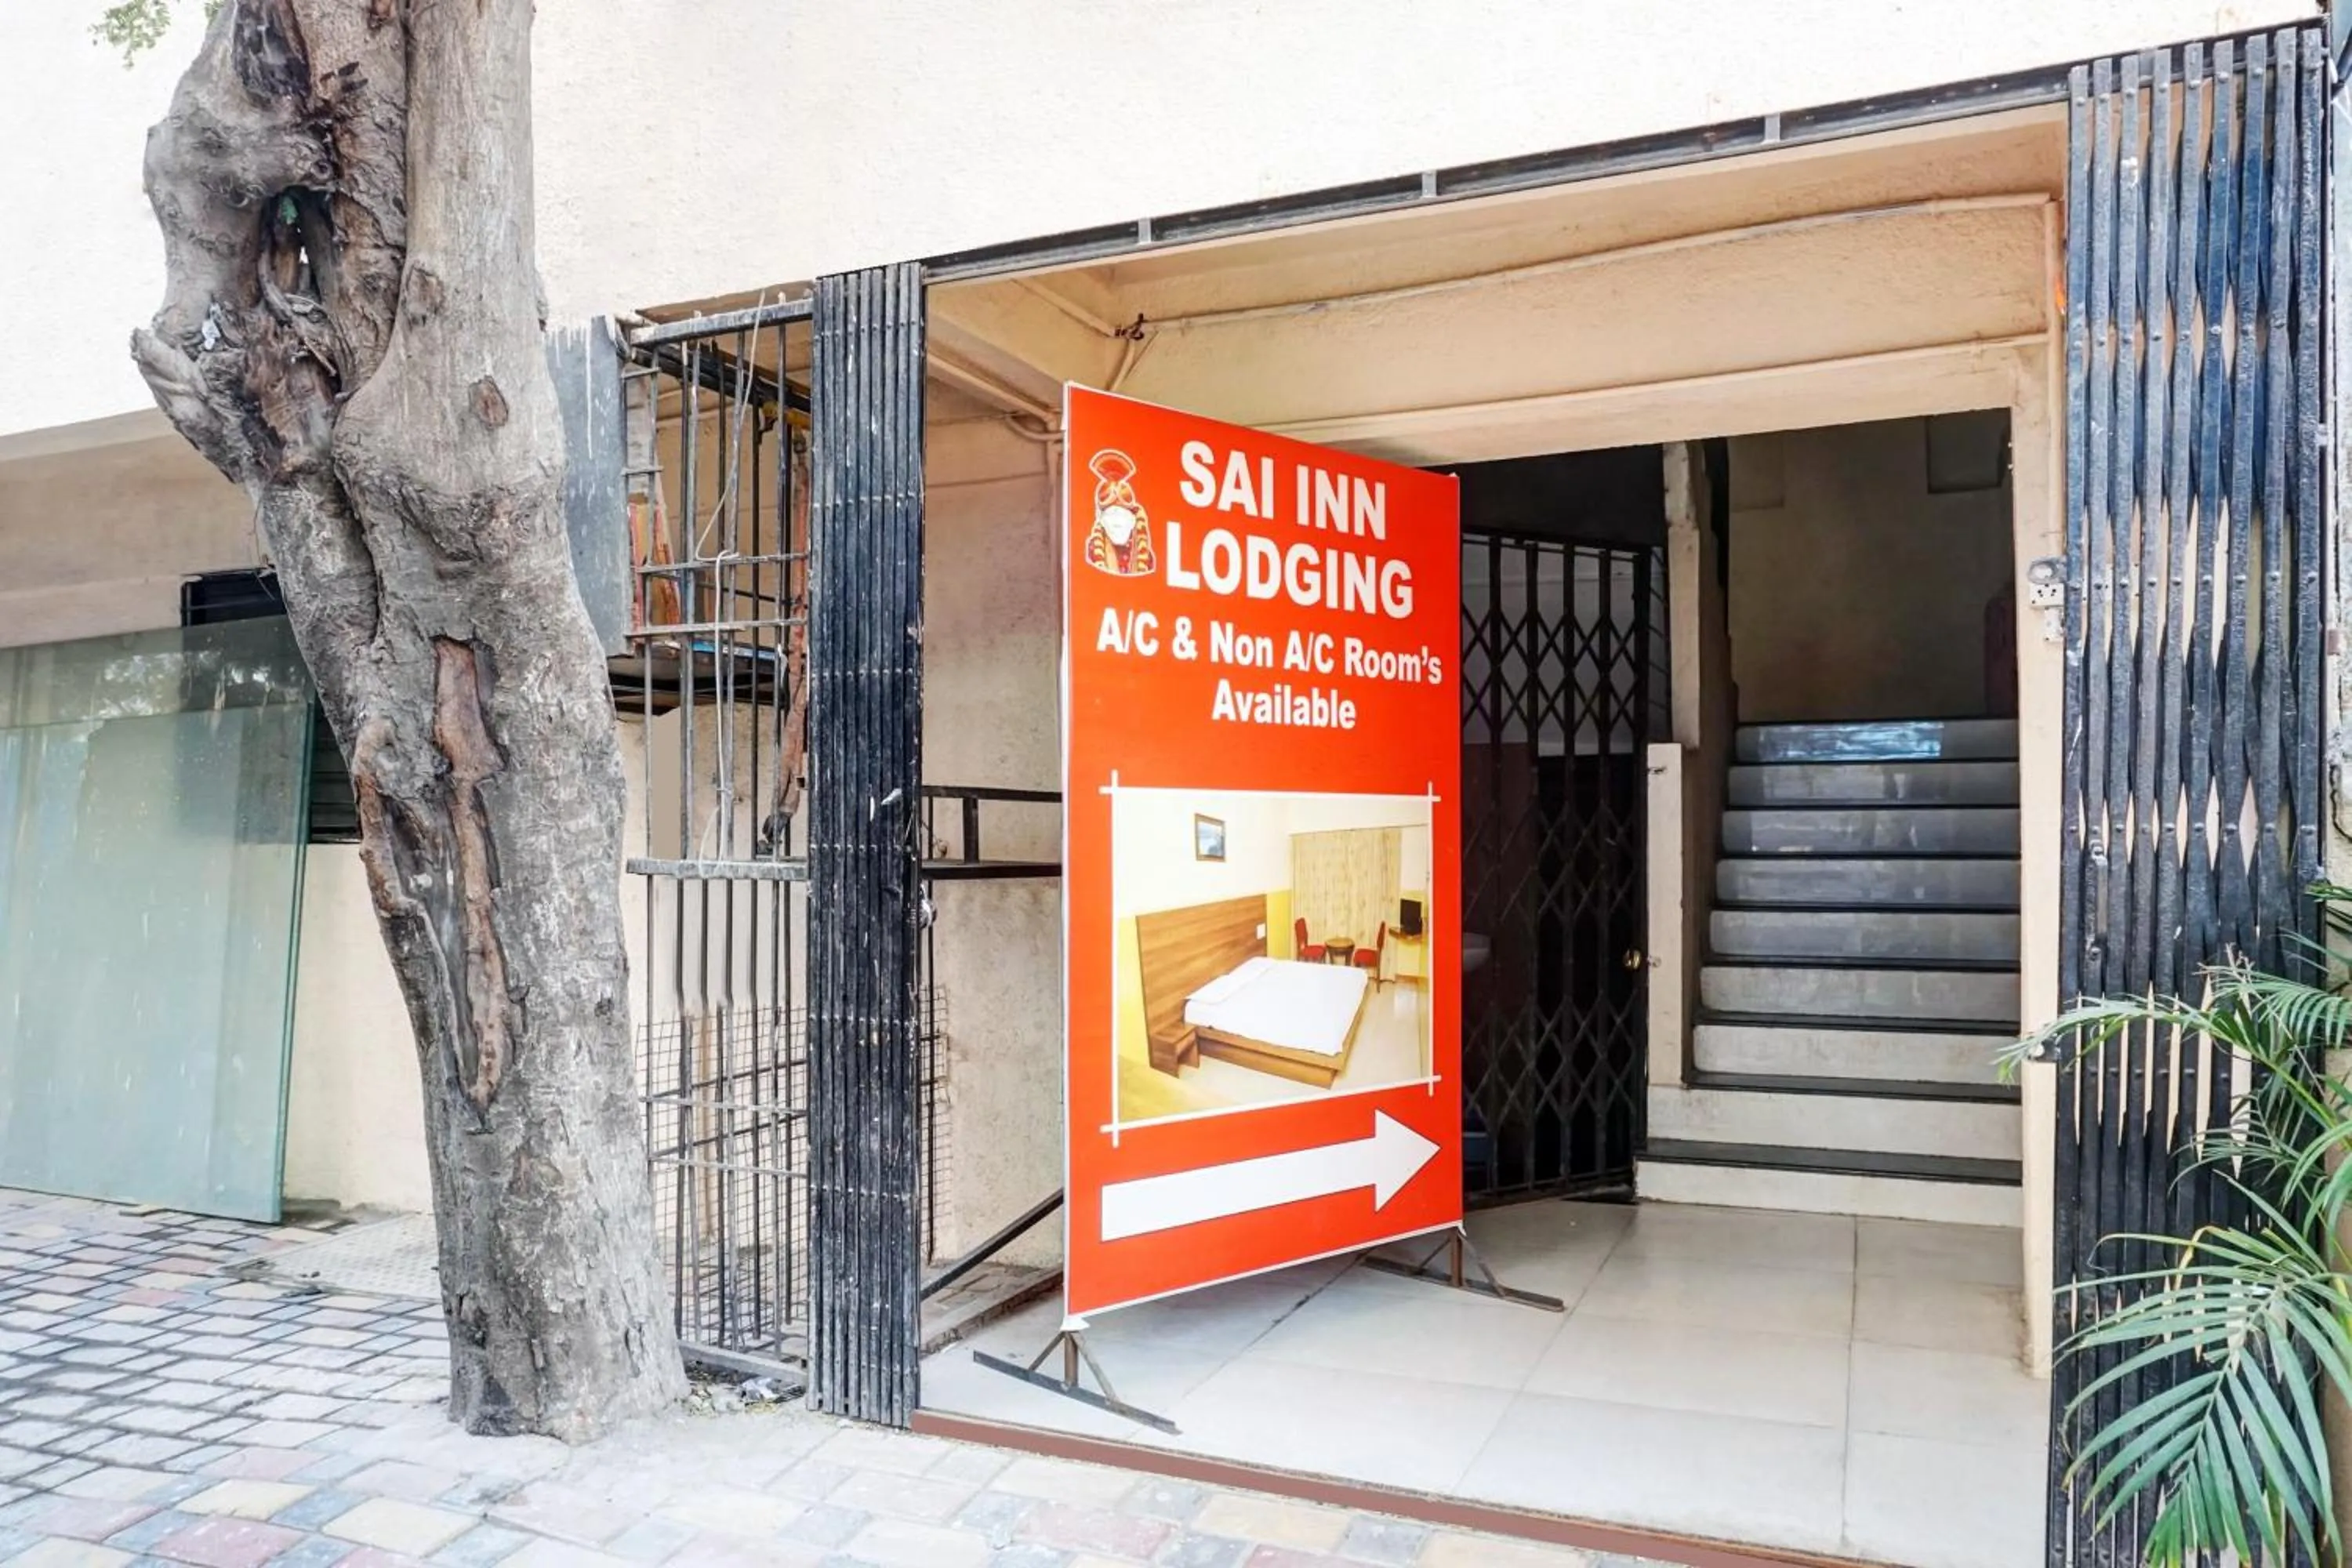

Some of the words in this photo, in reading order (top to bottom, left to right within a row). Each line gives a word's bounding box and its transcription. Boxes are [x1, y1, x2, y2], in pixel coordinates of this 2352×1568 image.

[1180, 441, 1274, 519] SAI
[1298, 466, 1385, 540] INN
[1166, 521, 1412, 619] LODGING
[1097, 607, 1160, 657] A/C
[1171, 616, 1198, 660] &
[1210, 620, 1273, 668] Non
[1283, 630, 1334, 673] A/C
[1345, 637, 1442, 684] Room's
[1211, 678, 1356, 729] Available
